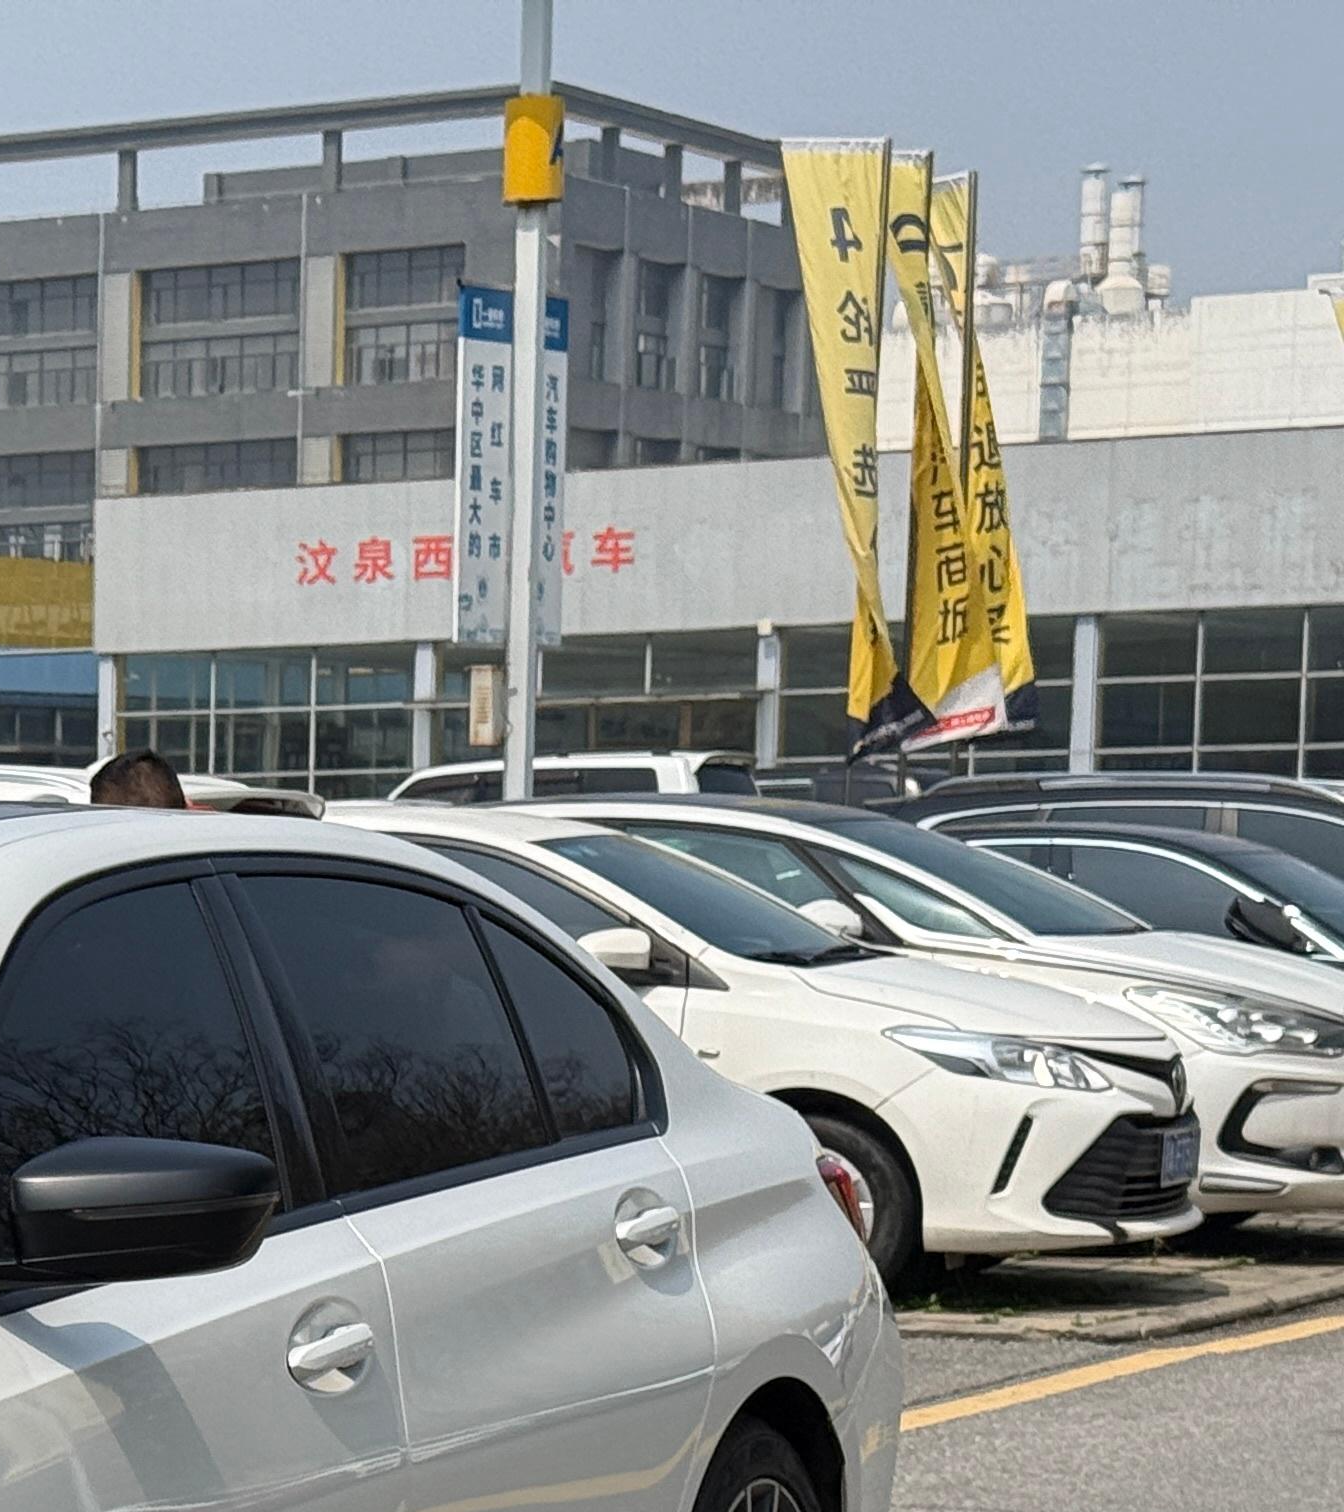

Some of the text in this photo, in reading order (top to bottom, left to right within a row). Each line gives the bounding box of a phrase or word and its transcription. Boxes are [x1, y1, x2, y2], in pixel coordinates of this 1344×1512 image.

[466, 363, 486, 560] 华中区最大的
[542, 373, 560, 563] 汽车购物中心
